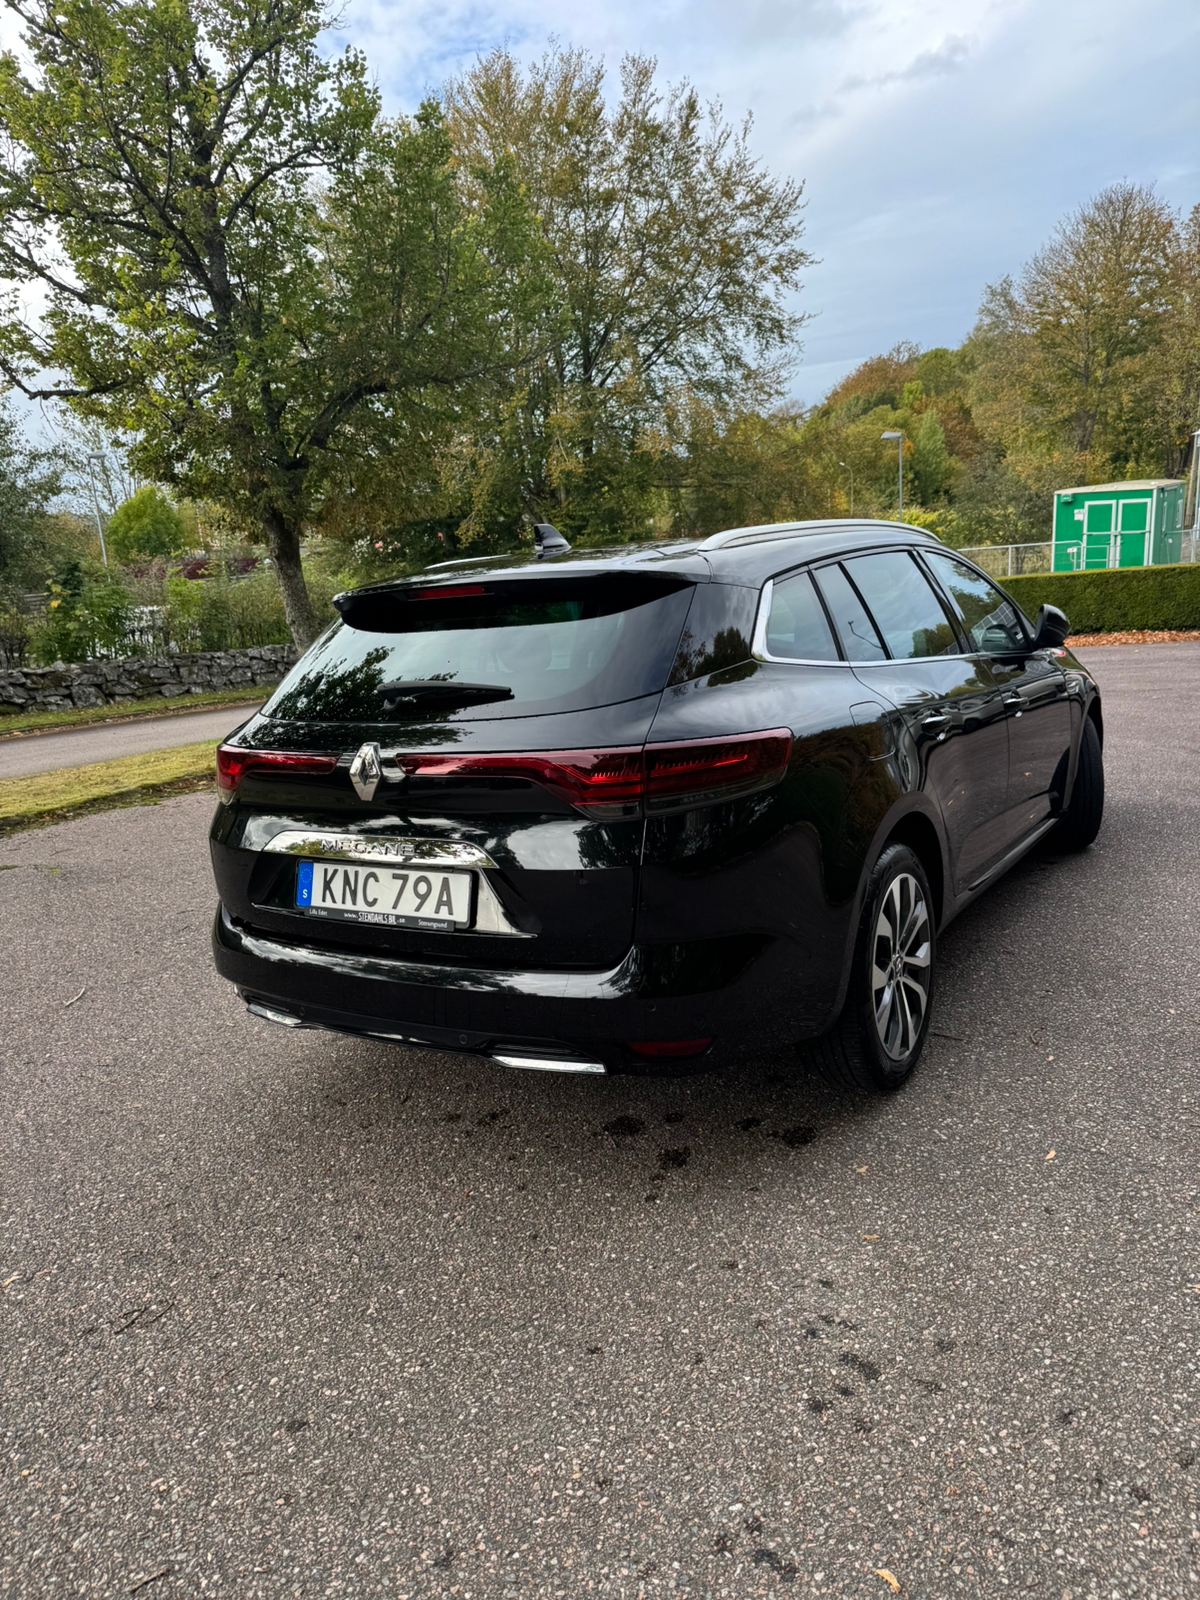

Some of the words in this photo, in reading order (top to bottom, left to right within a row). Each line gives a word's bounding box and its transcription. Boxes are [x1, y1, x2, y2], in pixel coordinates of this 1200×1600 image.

[319, 838, 416, 857] MEGANE
[302, 889, 308, 899] S
[321, 867, 380, 907] KNC
[391, 873, 454, 916] 79A
